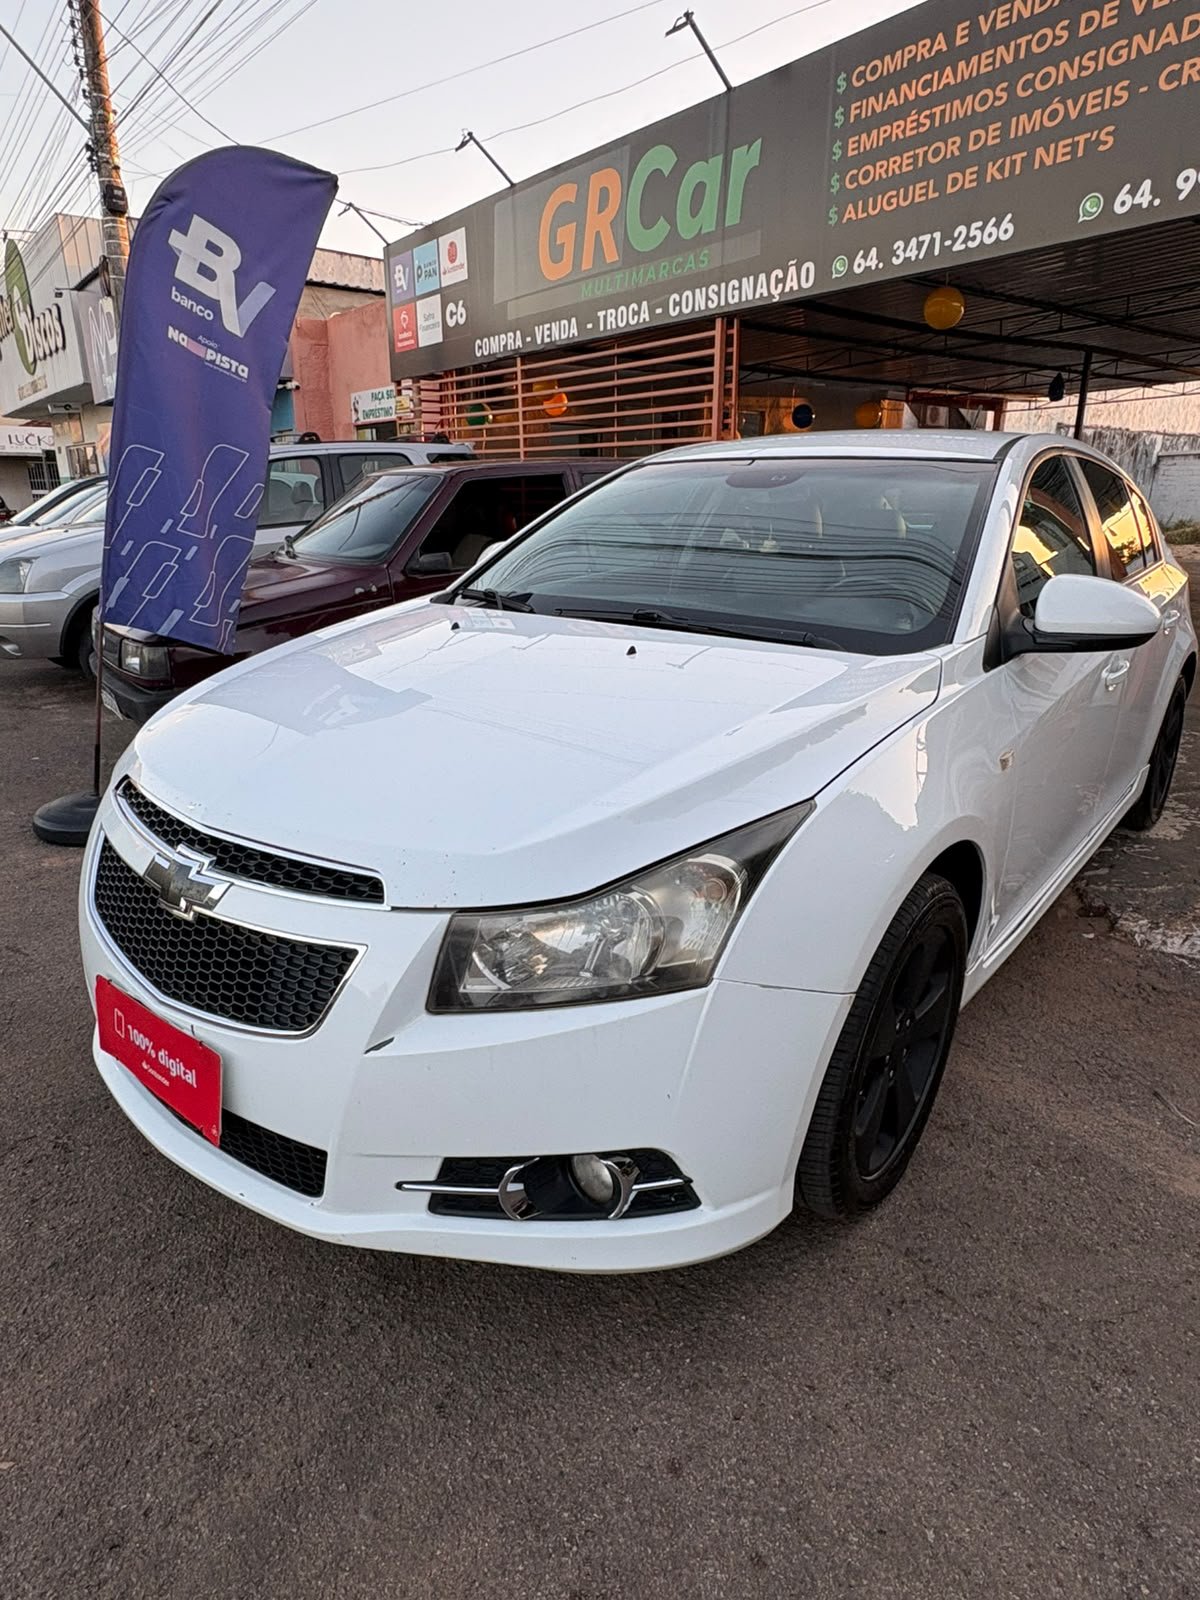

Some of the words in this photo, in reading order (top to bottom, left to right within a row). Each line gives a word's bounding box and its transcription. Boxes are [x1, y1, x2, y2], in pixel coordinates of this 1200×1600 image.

[847, 82, 1009, 158] EMPRÉSTIMOS
[1016, 12, 1200, 98] CONSIGNAD
[849, 19, 1071, 124] FINANCIAMENTOS
[1078, 0, 1121, 38] DE
[851, 32, 948, 88] COMPRA
[955, 21, 971, 47] E
[844, 136, 962, 190] CORRETOR
[967, 121, 1002, 152] DE
[1009, 80, 1131, 139] IMÓVEIS
[842, 178, 940, 224] ALUGUEL
[946, 166, 979, 195] DE
[986, 151, 1028, 183] KIT
[1113, 178, 1161, 215] 64.
[581, 248, 711, 298] MULTIMARCAS
[853, 247, 884, 275] 64.
[891, 213, 1015, 266] 3471-2566
[170, 286, 214, 321] banco
[445, 299, 467, 328] C6
[474, 330, 523, 358] COMPRA
[535, 317, 578, 345] VENDA
[597, 300, 650, 332] TROCA
[668, 259, 816, 318] CONSIGNAÇÃO
[127, 1024, 156, 1059] 100%
[158, 1048, 197, 1088] digital
